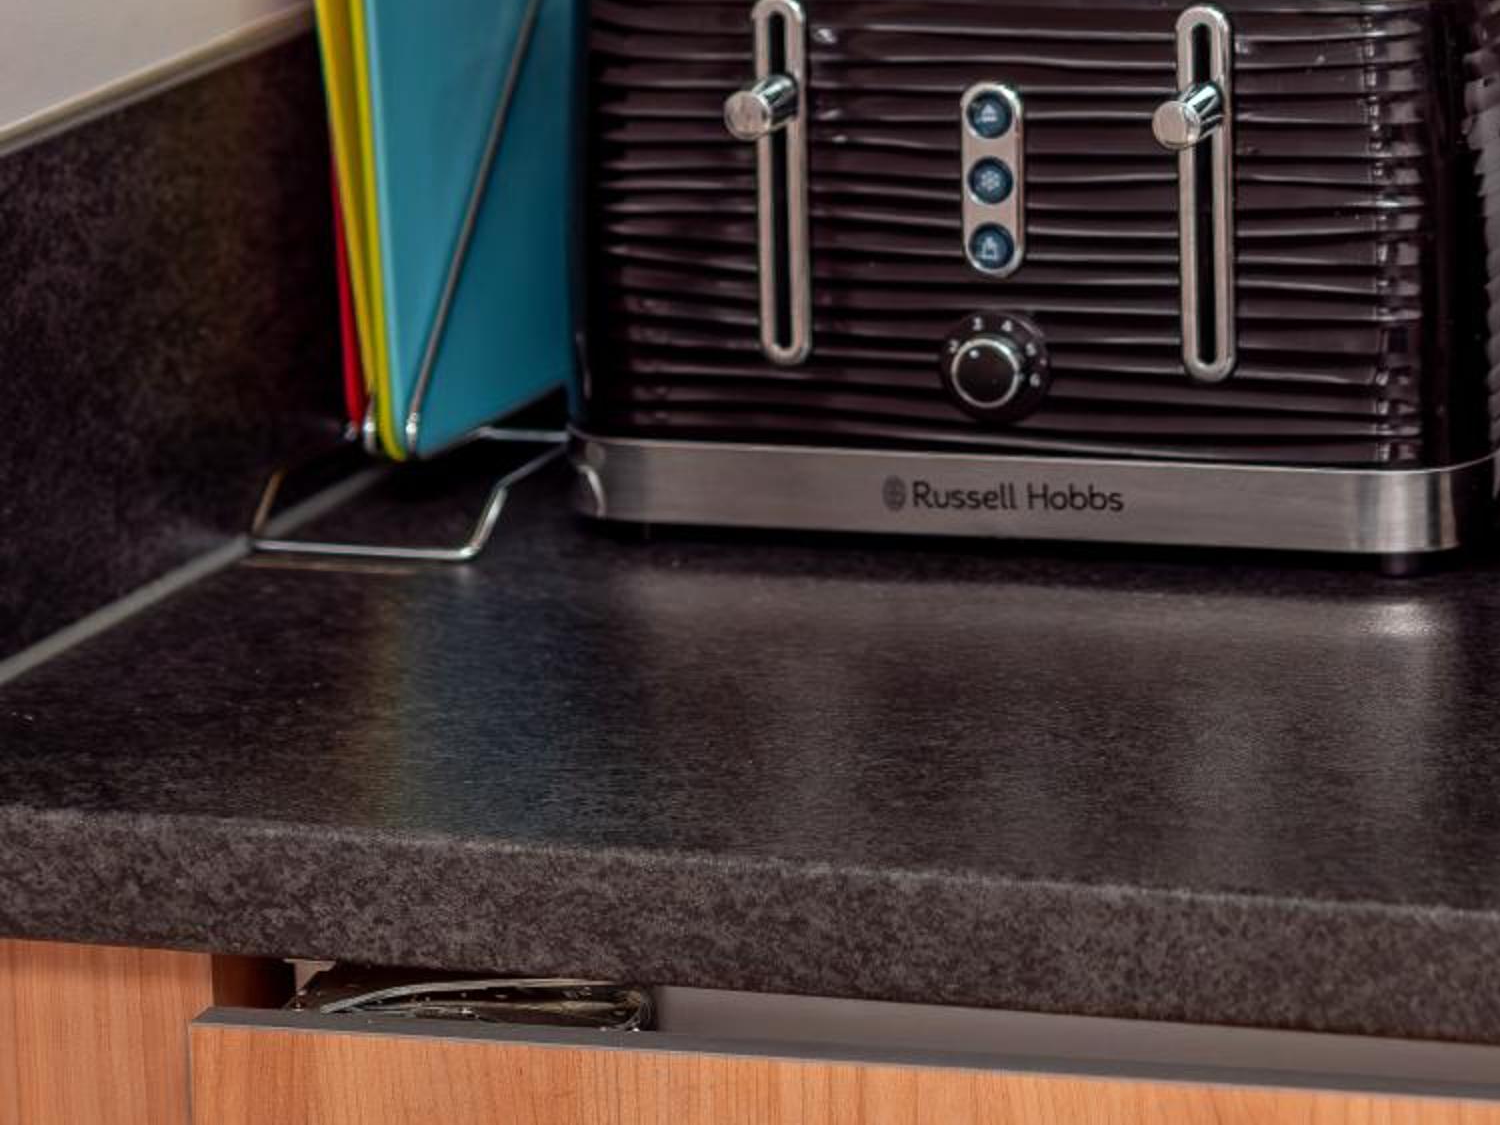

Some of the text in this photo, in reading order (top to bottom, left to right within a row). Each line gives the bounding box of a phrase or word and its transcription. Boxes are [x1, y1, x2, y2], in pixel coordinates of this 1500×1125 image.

[1001, 319, 1013, 332] 4
[912, 480, 1124, 512] Russell Hobbs
